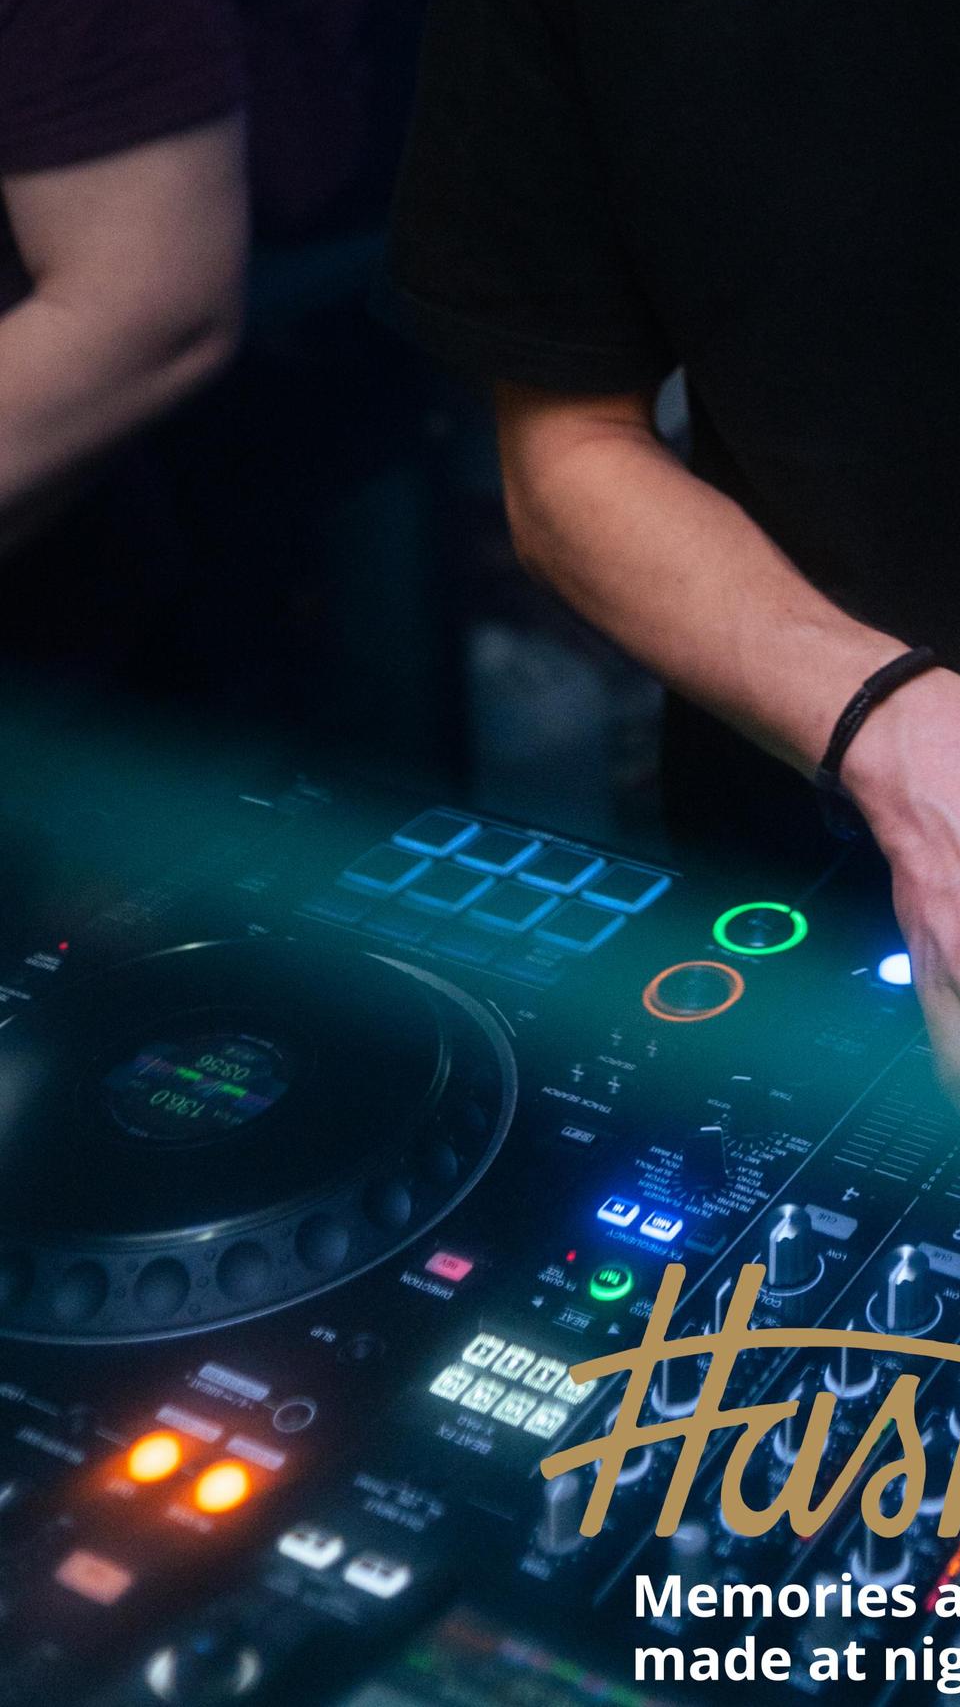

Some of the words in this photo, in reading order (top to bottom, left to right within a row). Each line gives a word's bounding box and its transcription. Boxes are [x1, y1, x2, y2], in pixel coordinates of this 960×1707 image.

[541, 1086, 583, 1105] SEARCH
[582, 1096, 612, 1114] TRACK
[701, 1201, 731, 1217] TRANS
[604, 1228, 669, 1256] FREQUENCY
[824, 1248, 848, 1262] LOW
[400, 1269, 454, 1301] DIRECTION
[558, 1310, 591, 1330] BEAT
[309, 1325, 337, 1345] SLIP
